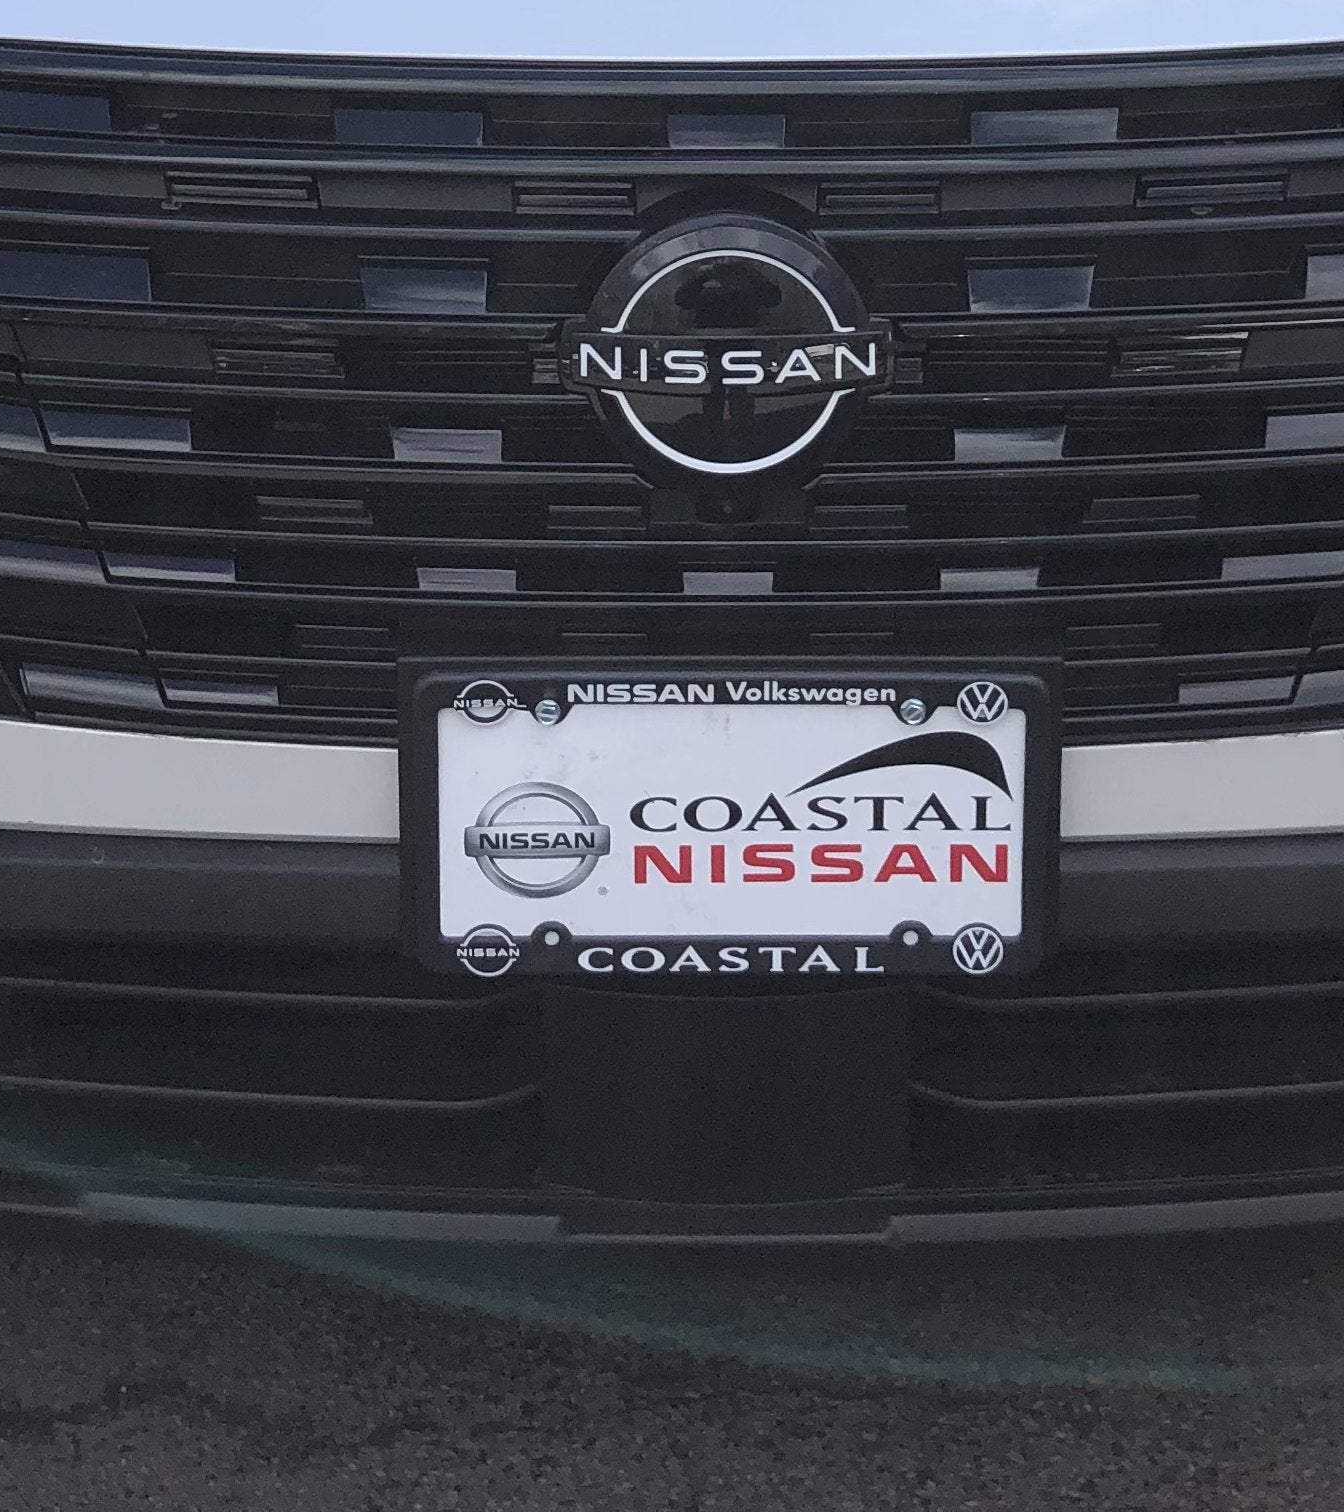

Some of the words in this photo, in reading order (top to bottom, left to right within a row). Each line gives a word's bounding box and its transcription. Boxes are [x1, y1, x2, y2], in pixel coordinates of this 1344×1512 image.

[579, 342, 876, 385] NISSAN
[453, 698, 518, 708] NISSAN
[567, 683, 715, 704] NISSAN
[725, 681, 896, 705] Volkswagen
[629, 791, 1012, 833] COASTAL
[478, 831, 596, 851] NISSAN
[634, 843, 1009, 884] NISSAN
[456, 947, 520, 958] NISSAN
[577, 944, 885, 973] COASTAL
